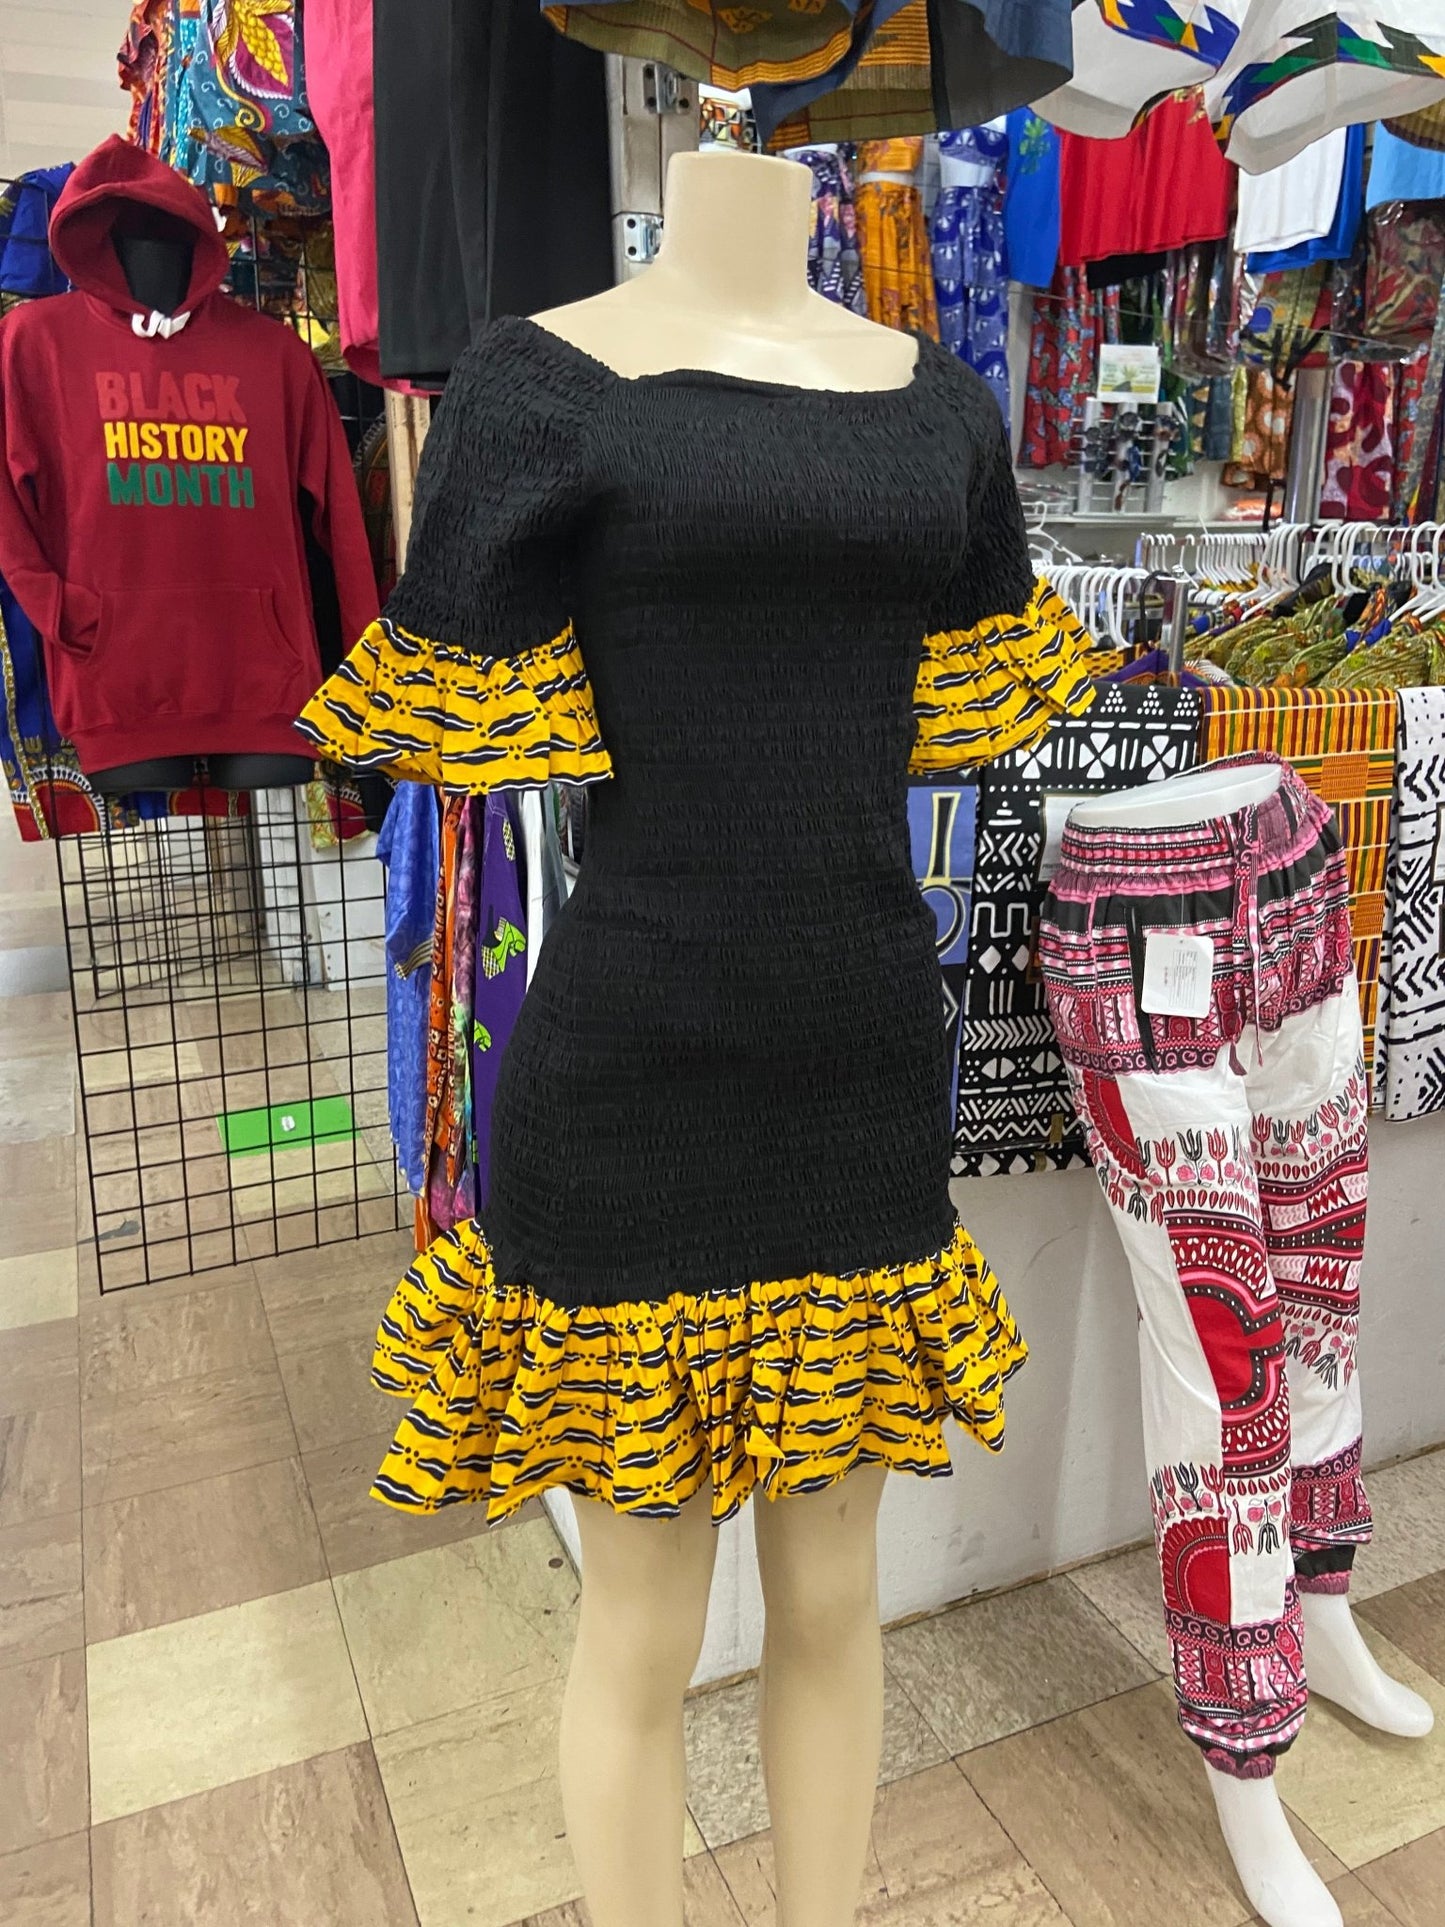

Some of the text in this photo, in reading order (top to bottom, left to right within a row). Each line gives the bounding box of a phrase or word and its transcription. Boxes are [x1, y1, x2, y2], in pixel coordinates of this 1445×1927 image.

[96, 371, 247, 423] BLACK
[104, 421, 248, 463] HISTORY
[107, 462, 255, 508] MONTH
